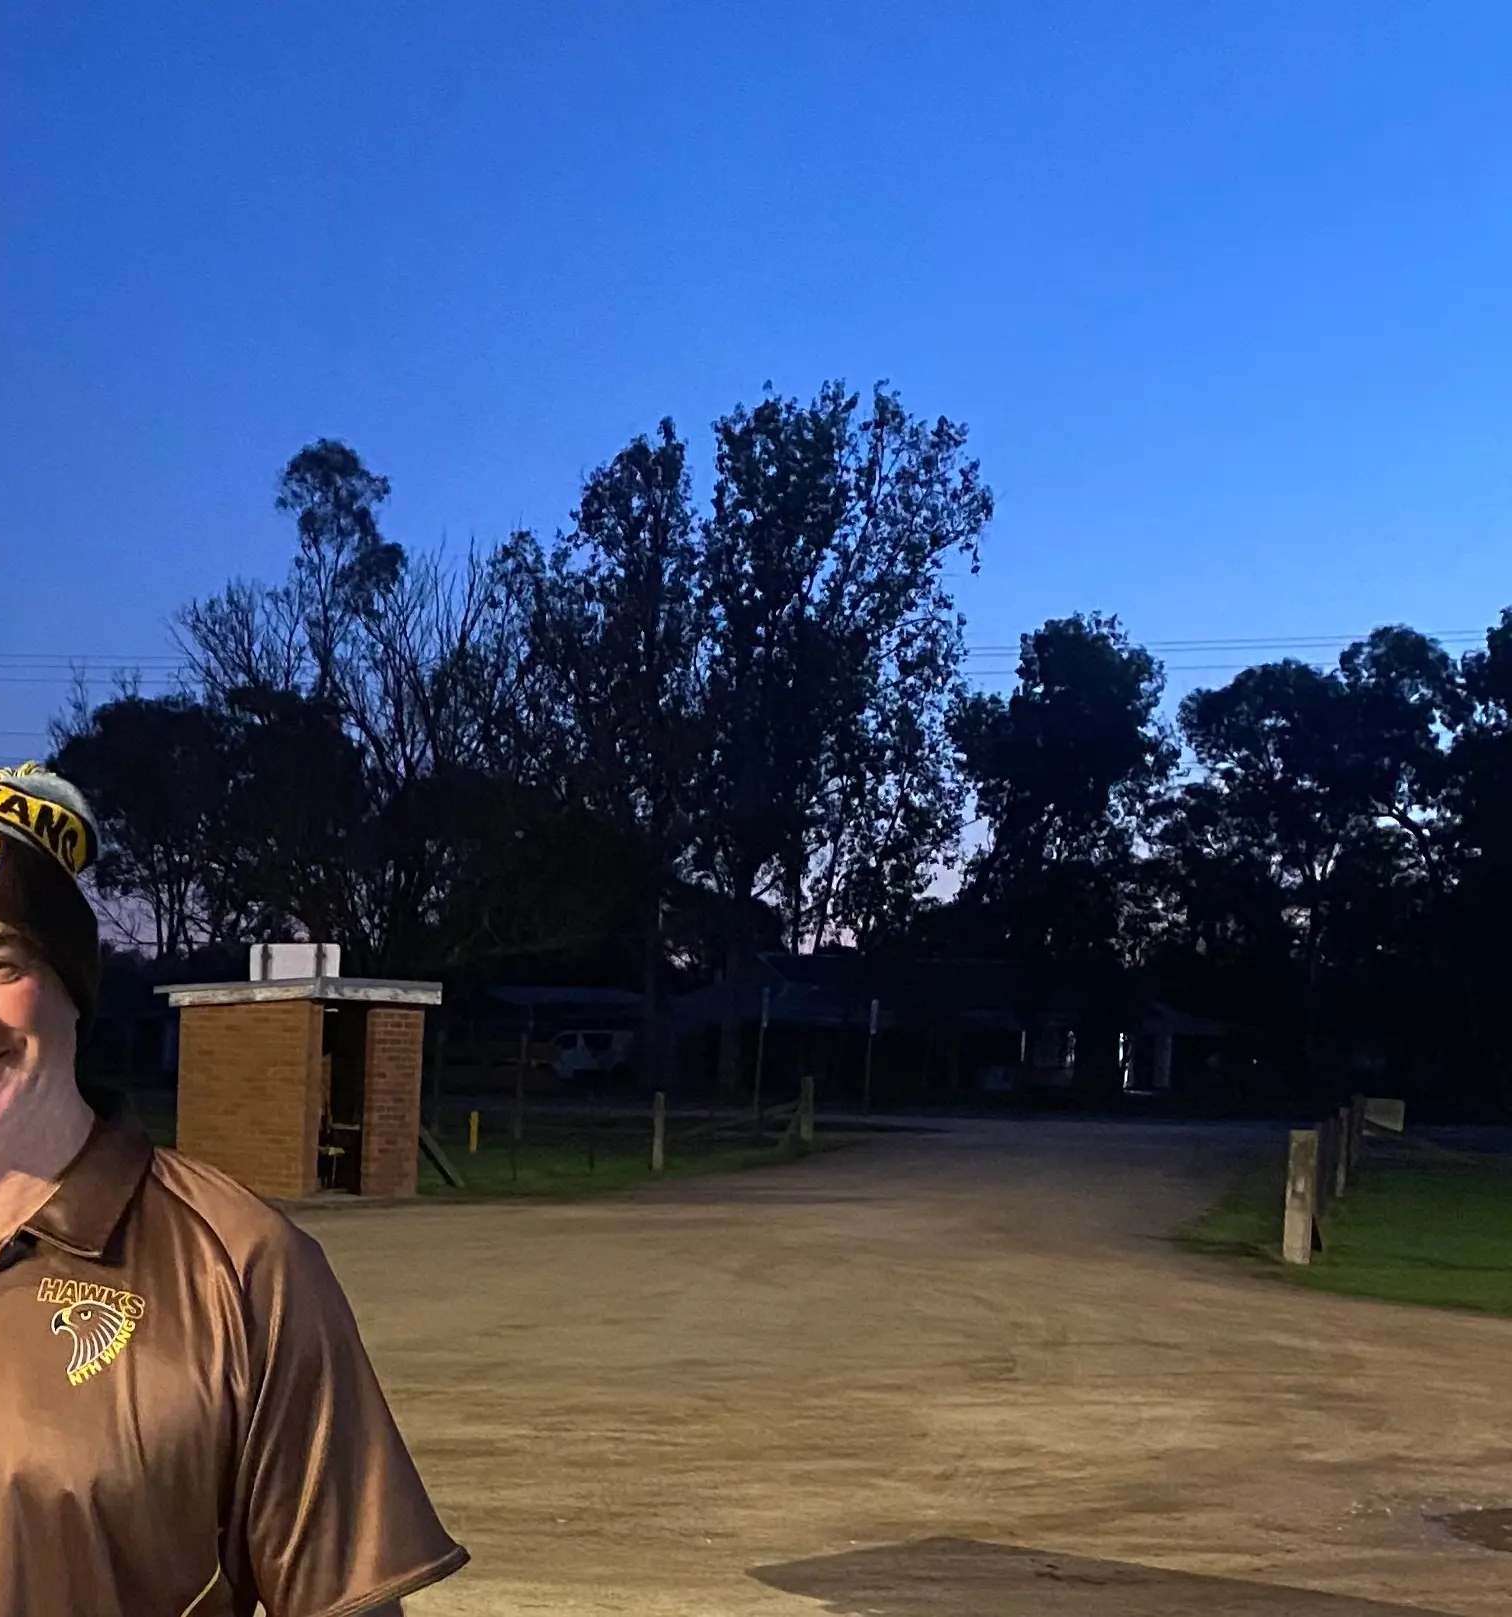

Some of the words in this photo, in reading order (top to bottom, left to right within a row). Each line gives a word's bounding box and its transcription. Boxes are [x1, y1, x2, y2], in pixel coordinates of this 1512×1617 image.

[37, 1277, 145, 1319] HAWKS
[68, 1360, 102, 1386] NTH
[100, 1319, 136, 1364] WANG
